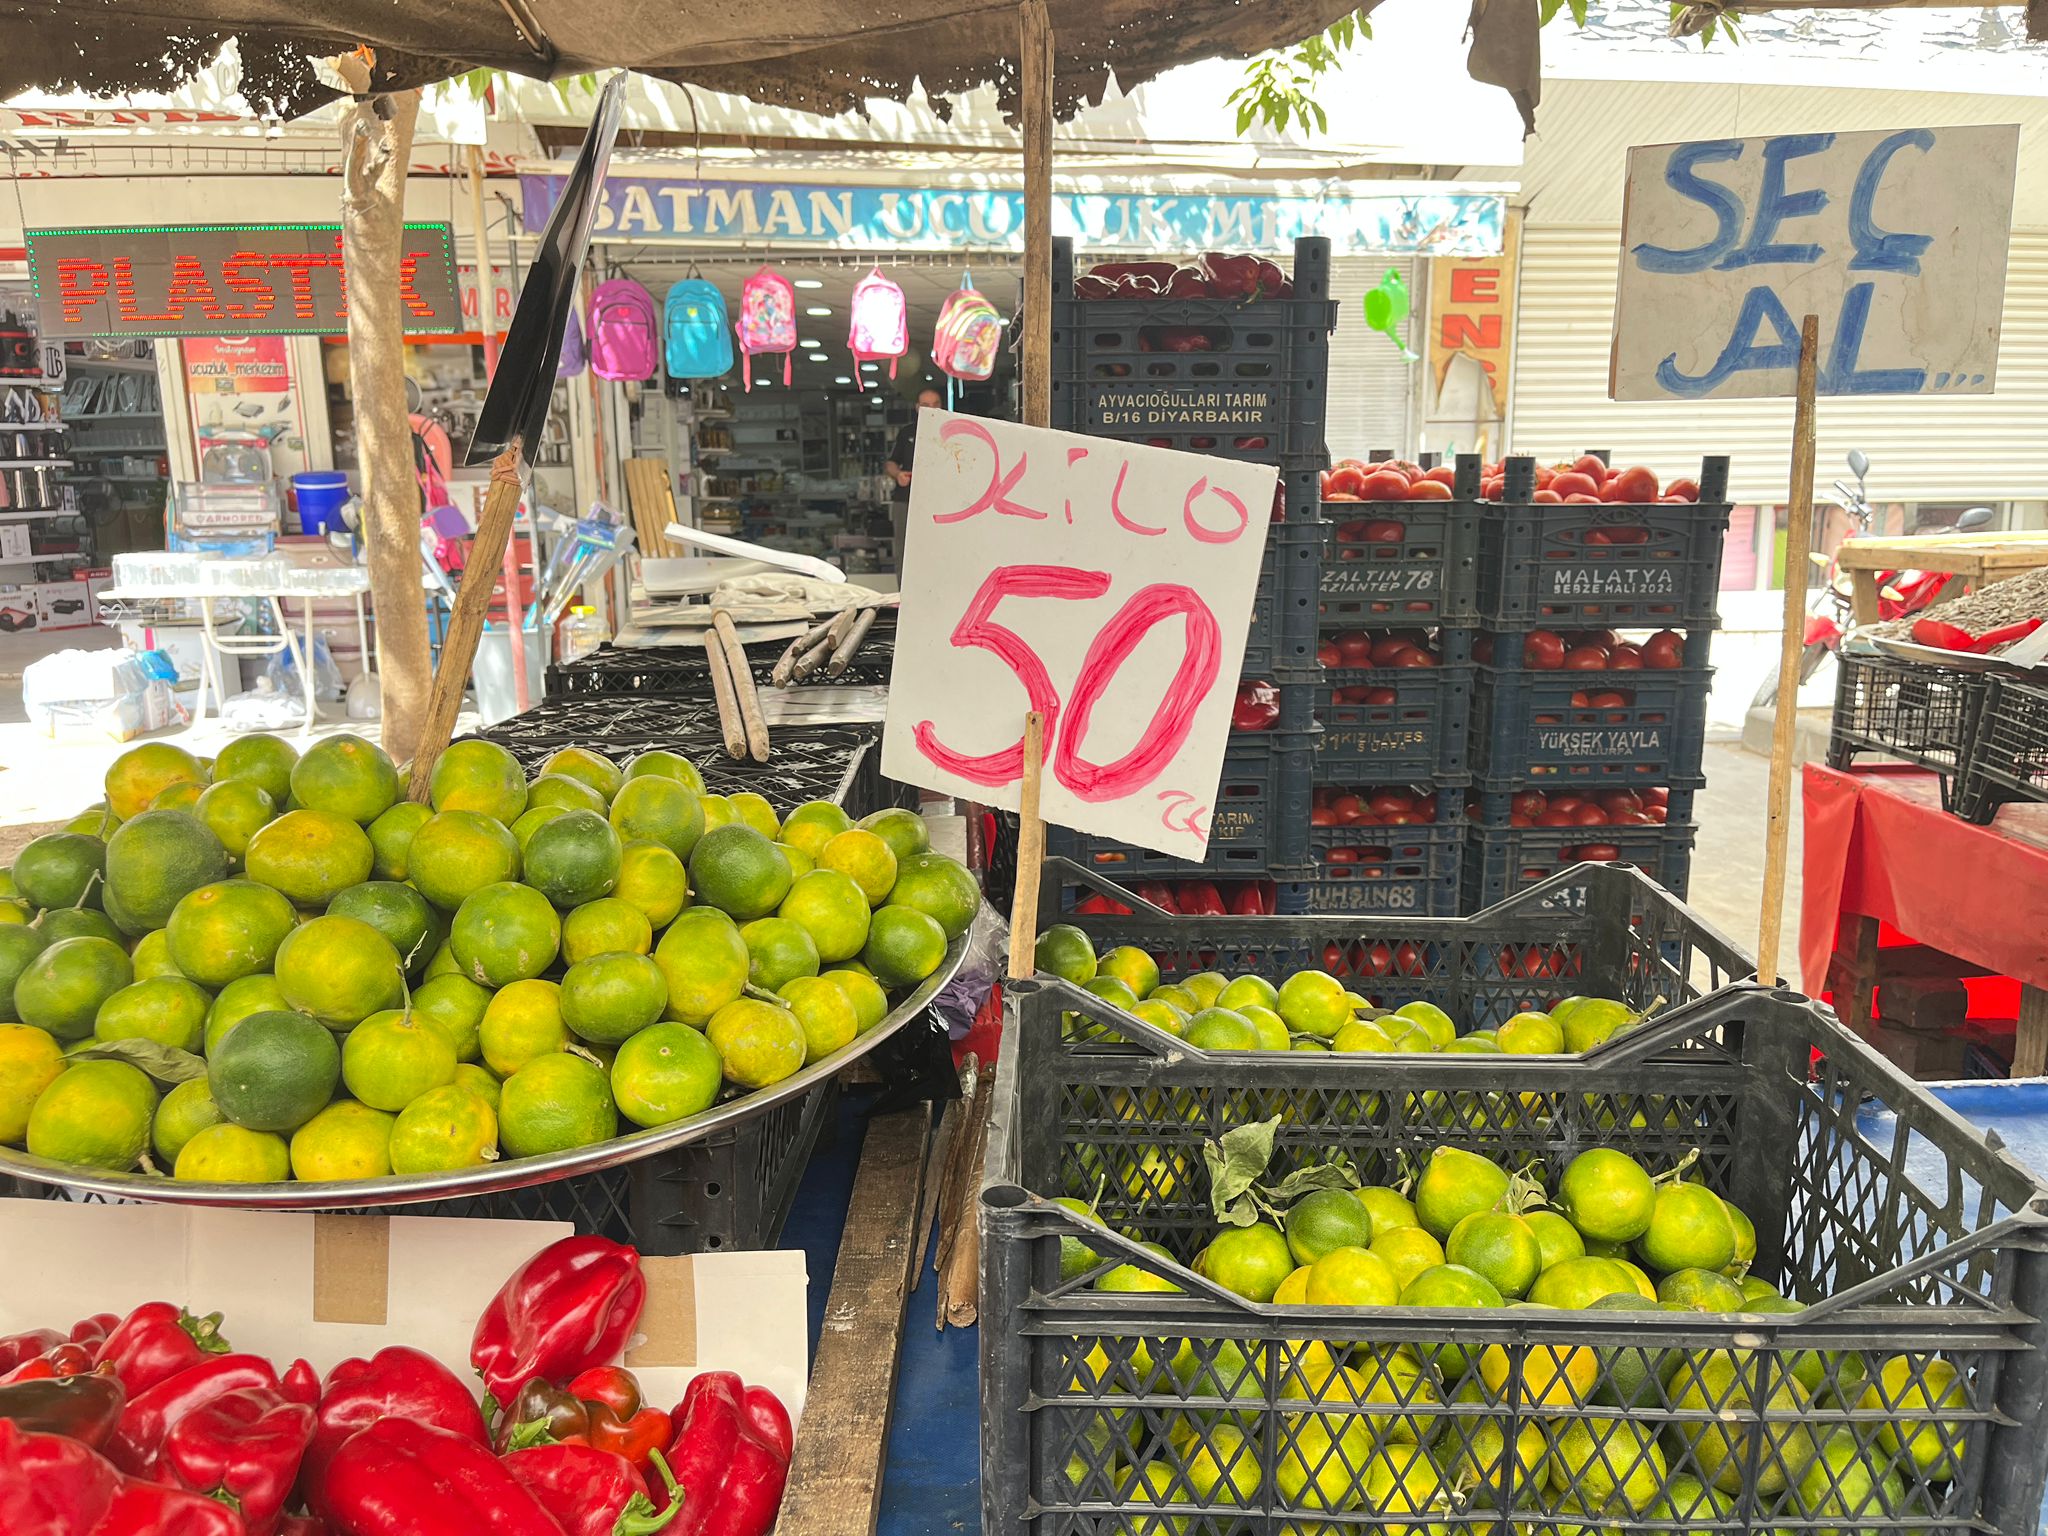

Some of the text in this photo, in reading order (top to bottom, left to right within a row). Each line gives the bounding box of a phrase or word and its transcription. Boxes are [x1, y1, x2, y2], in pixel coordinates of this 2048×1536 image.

[879, 192, 1179, 243] UCUUK
[1225, 393, 1268, 407] TARIM
[1102, 408, 1263, 424] B/16 DİYARBAKIR
[1320, 569, 1401, 582] ZALTIN
[1403, 569, 1434, 590] 78
[1554, 568, 1673, 584] MALATYA
[1553, 584, 1600, 594] SEBZE
[912, 564, 1222, 804] 50
[1540, 730, 1660, 749] YÜKSEK YAYLA
[1214, 812, 1254, 825] ARIM
[1388, 885, 1416, 909] 63
